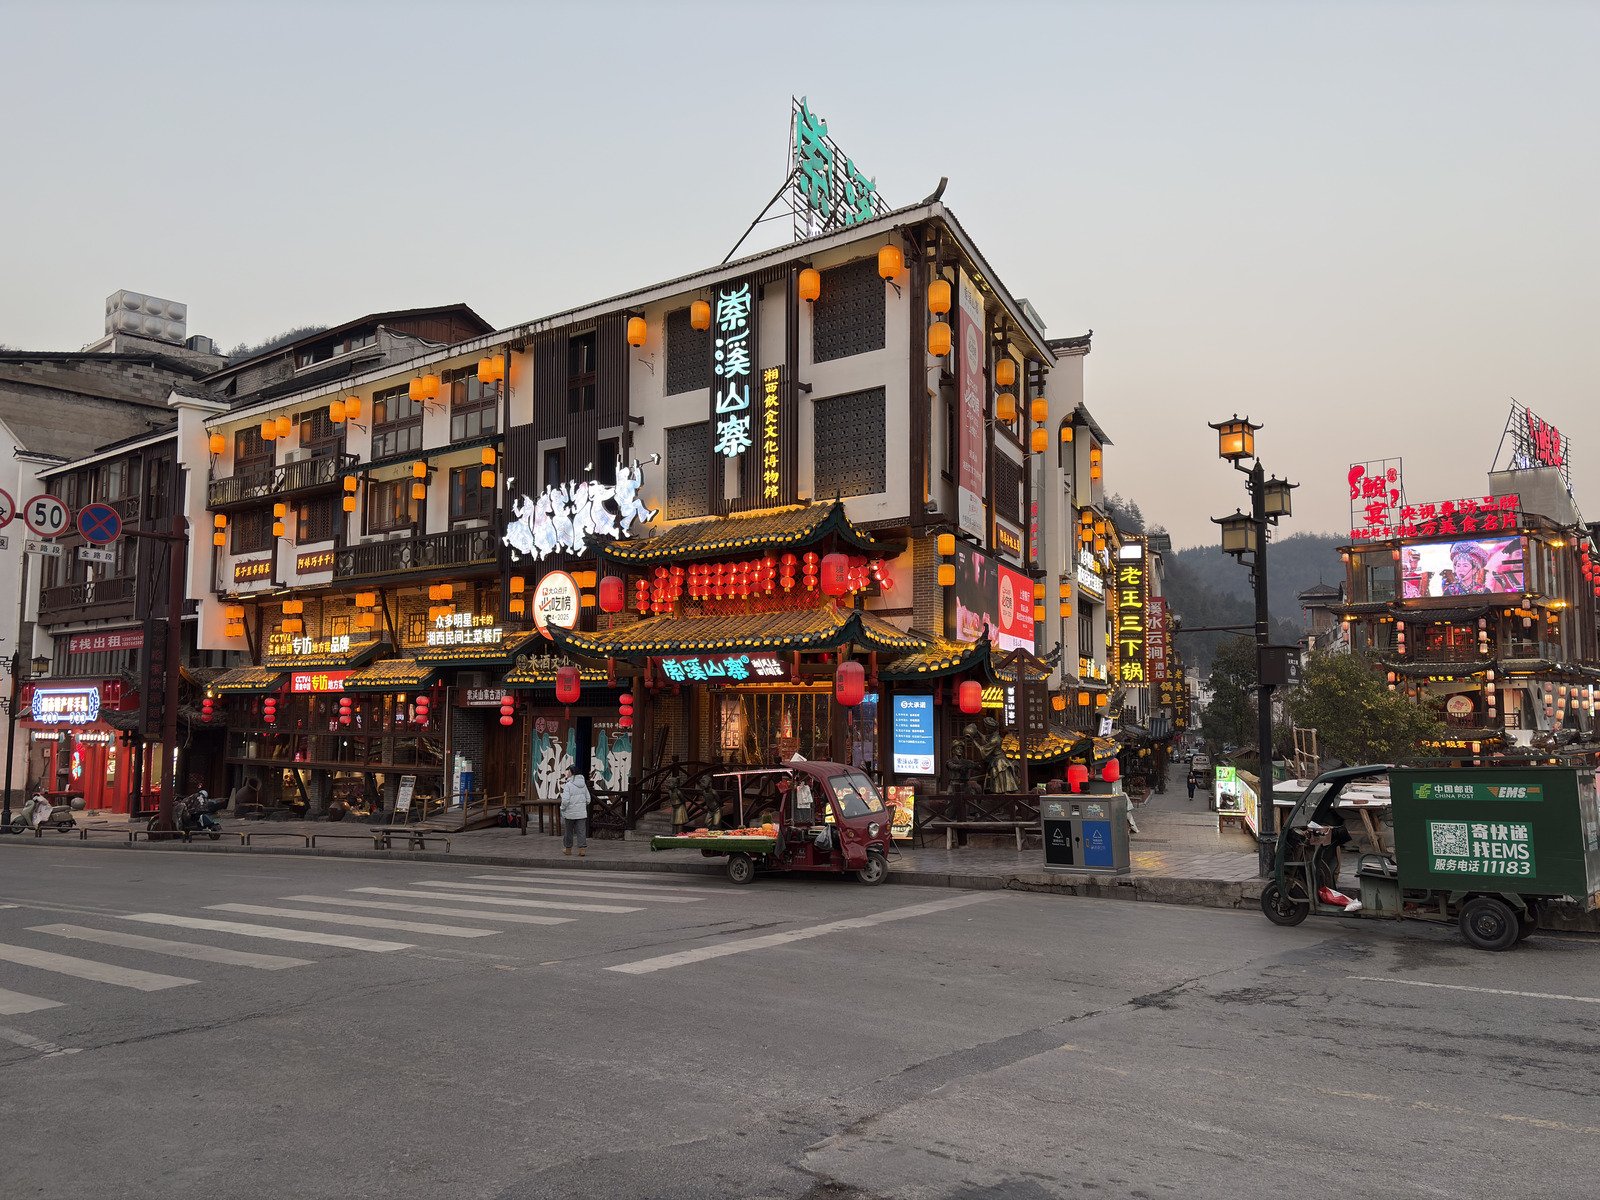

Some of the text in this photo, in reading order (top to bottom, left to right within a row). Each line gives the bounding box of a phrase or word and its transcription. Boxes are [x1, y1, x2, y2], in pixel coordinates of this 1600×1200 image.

[35, 503, 62, 528] 50
[1400, 494, 1520, 521] 央視專訪品牌
[1397, 511, 1518, 537] 地方美食名片
[28, 543, 60, 554] 全路段
[82, 550, 113, 561] 全路段
[435, 613, 494, 629] 众多明星 打卡的
[1119, 566, 1143, 681] 老王三下锅
[268, 634, 350, 656] 美食中国 专访 地方菜 品牌
[270, 634, 291, 643] CCTV4
[427, 628, 503, 645] 湘西民间土菜餐厅
[529, 653, 581, 671] 米酒文化
[1155, 662, 1165, 679] 酒店
[312, 675, 328, 690] 专访
[1434, 785, 1474, 794] 中国邮政
[1498, 787, 1527, 799] EMS
[1471, 824, 1529, 842] 寄快递
[1472, 842, 1530, 860] 找EMS
[1434, 859, 1531, 875] 服务电话 11183
